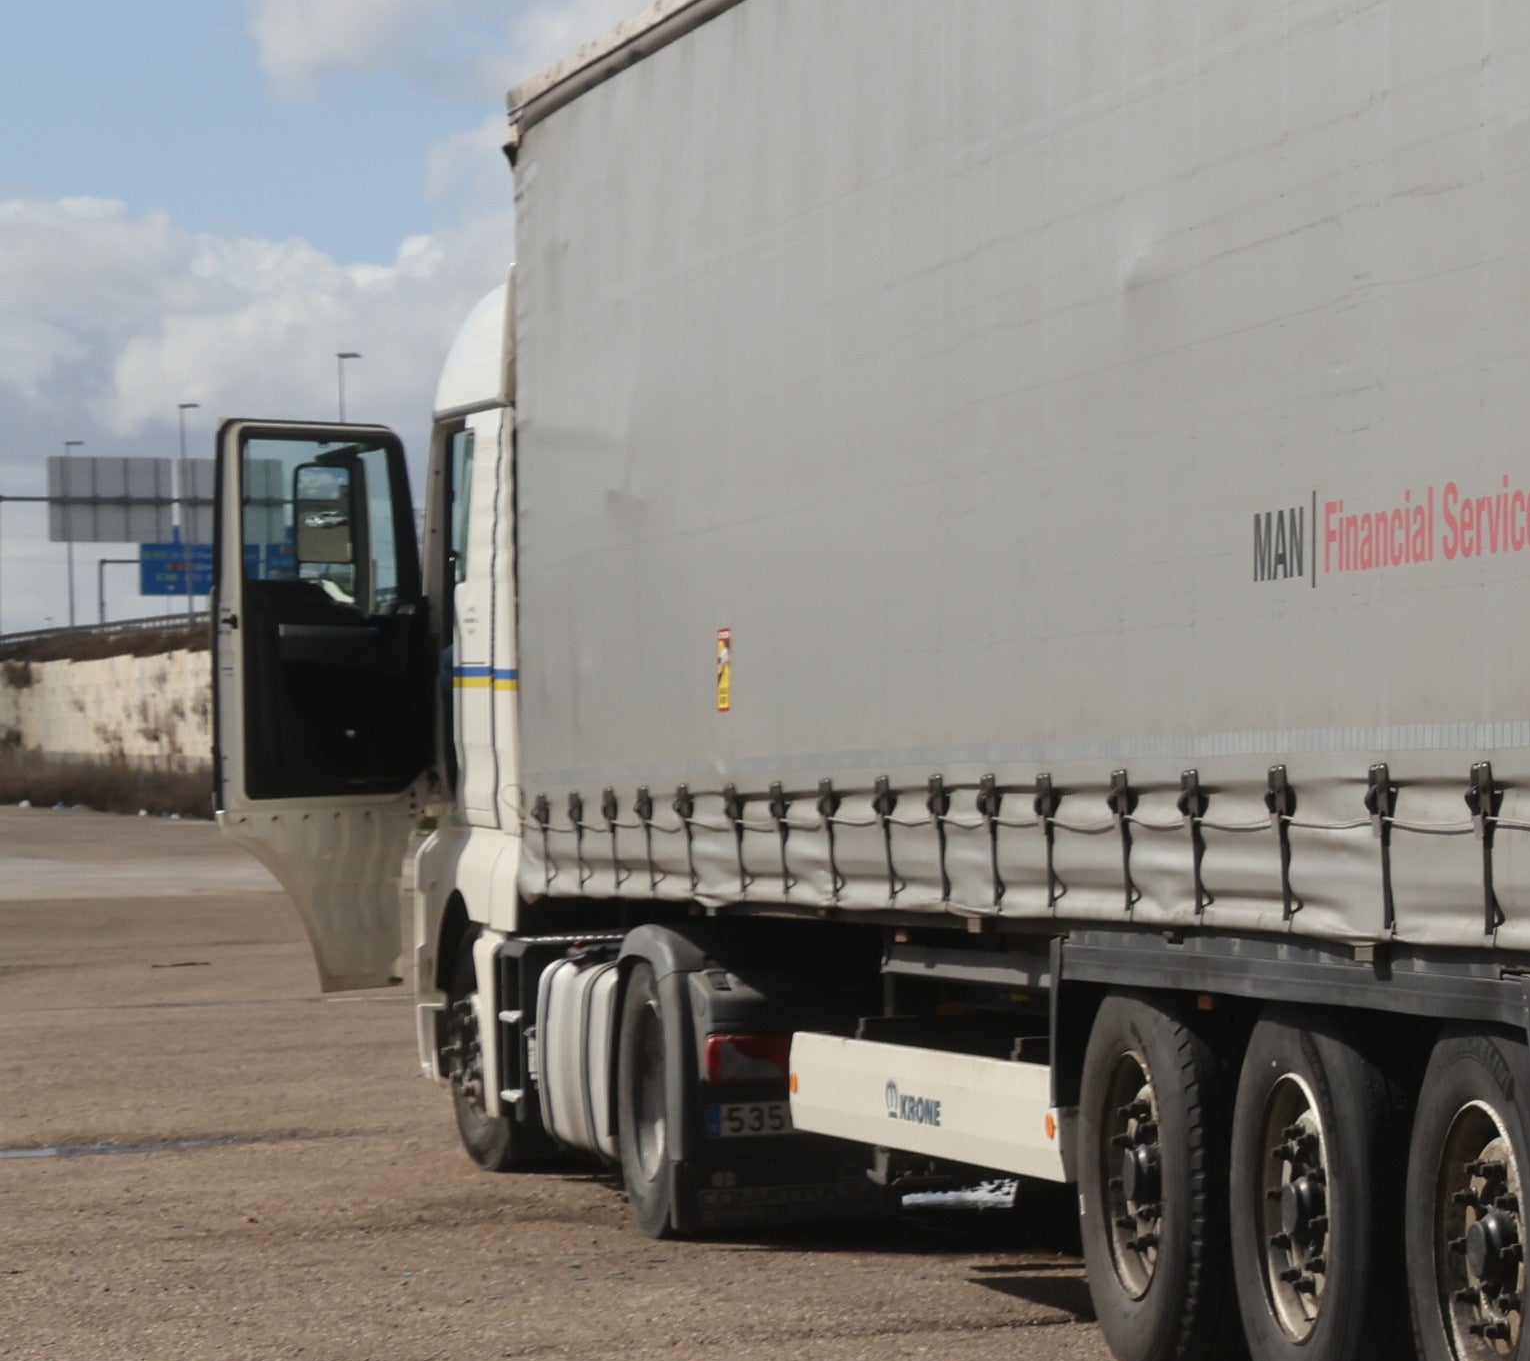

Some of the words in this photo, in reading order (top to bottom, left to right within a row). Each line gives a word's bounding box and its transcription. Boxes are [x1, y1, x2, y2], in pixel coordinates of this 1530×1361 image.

[1253, 506, 1304, 582] MAN
[1324, 486, 1433, 574] Financial
[900, 1094, 941, 1127] KRONE
